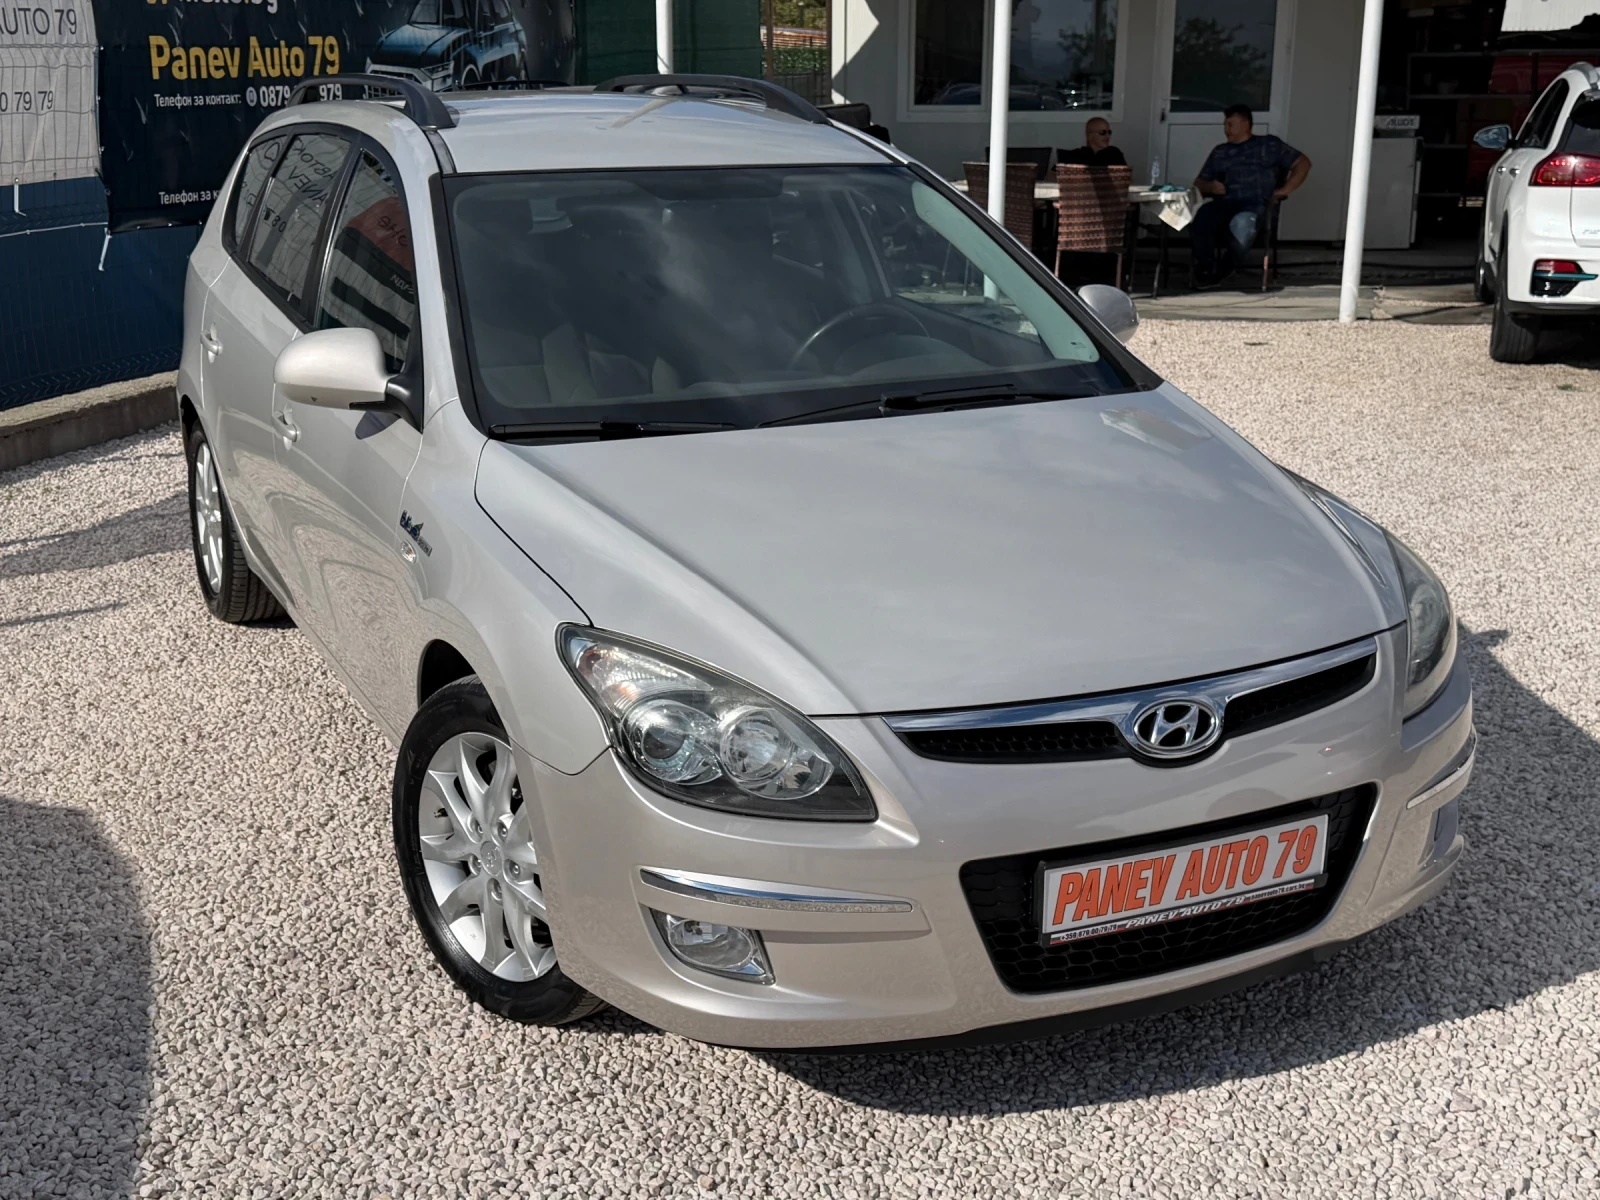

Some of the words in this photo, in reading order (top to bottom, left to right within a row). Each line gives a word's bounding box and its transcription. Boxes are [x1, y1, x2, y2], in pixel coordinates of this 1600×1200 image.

[54, 9, 77, 35] 79
[148, 35, 240, 80] Panev
[247, 36, 305, 77] Auto
[308, 35, 340, 76] 79
[14, 91, 32, 112] 79
[38, 90, 53, 111] 79
[154, 93, 192, 109] Телефон
[193, 94, 205, 105] за
[205, 94, 242, 105] контакт:
[159, 190, 198, 206] Телефон
[200, 191, 211, 201] за
[1052, 855, 1176, 926] PANEV
[1175, 835, 1269, 901] AUTO
[1273, 825, 1318, 879] 79
[1125, 909, 1180, 928] PANEV
[1180, 901, 1221, 917] AUTO
[1224, 895, 1246, 907] 79
